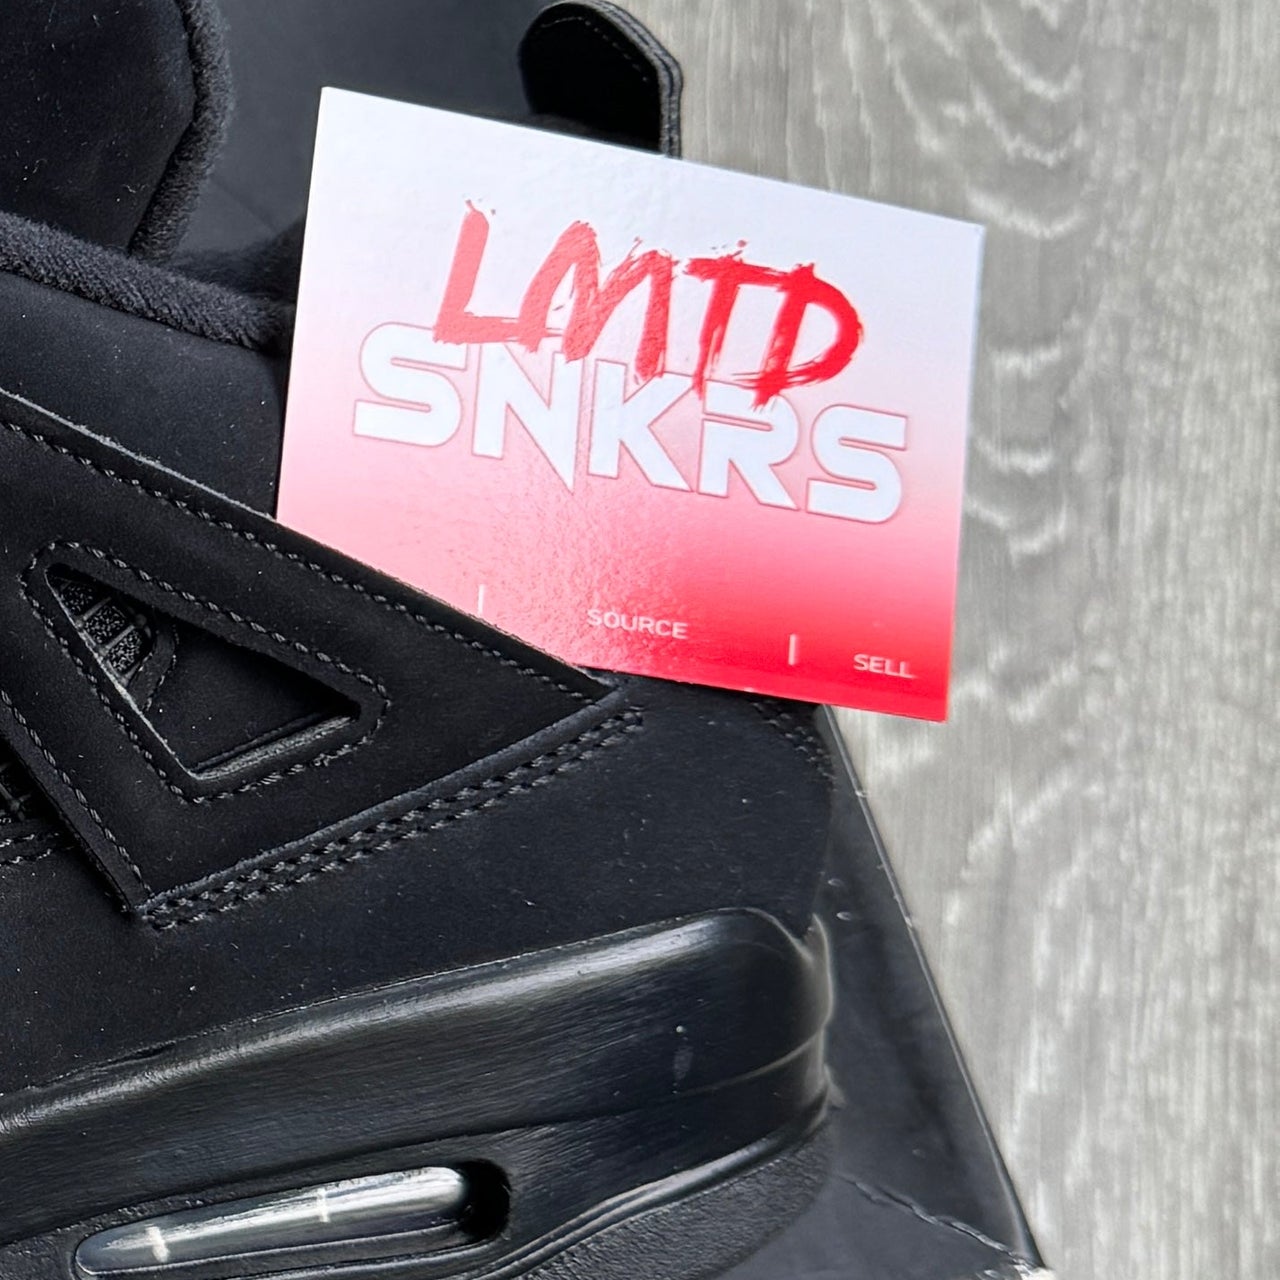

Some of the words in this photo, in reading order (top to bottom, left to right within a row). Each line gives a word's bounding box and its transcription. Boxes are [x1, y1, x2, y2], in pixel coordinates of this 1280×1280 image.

[432, 200, 865, 408] LMTD
[352, 321, 908, 524] SNKRS
[586, 608, 689, 640] SOURCE
[852, 653, 916, 680] SELL
